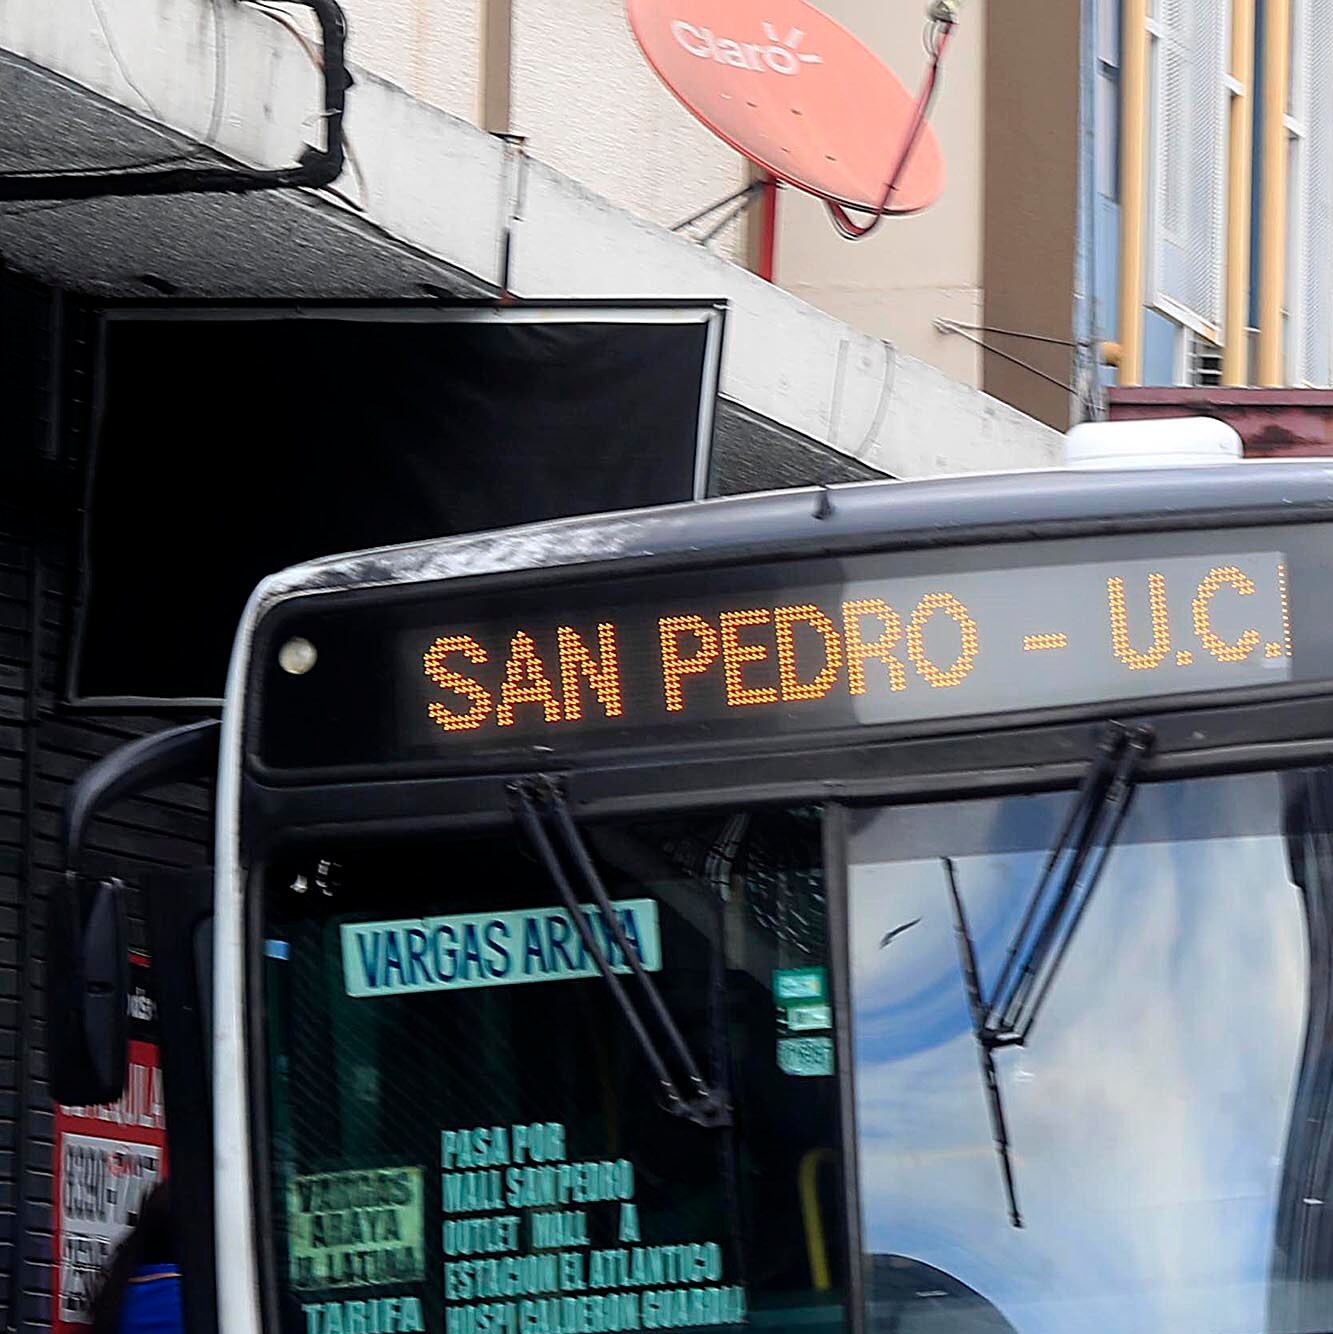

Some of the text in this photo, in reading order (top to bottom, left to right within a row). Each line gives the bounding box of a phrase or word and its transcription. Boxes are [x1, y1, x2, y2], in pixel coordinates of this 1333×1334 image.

[671, 19, 800, 76] Claro
[422, 622, 622, 732] SAN
[659, 591, 978, 712] PEDRO
[356, 918, 514, 989] VARGAS
[441, 1121, 567, 1170] PASA POR
[441, 1158, 635, 1214] MALL SAN PEDRO
[442, 1201, 641, 1257] OUTLET MALL A
[558, 1251, 588, 1291] EL
[588, 1241, 723, 1289] ATLANTICO
